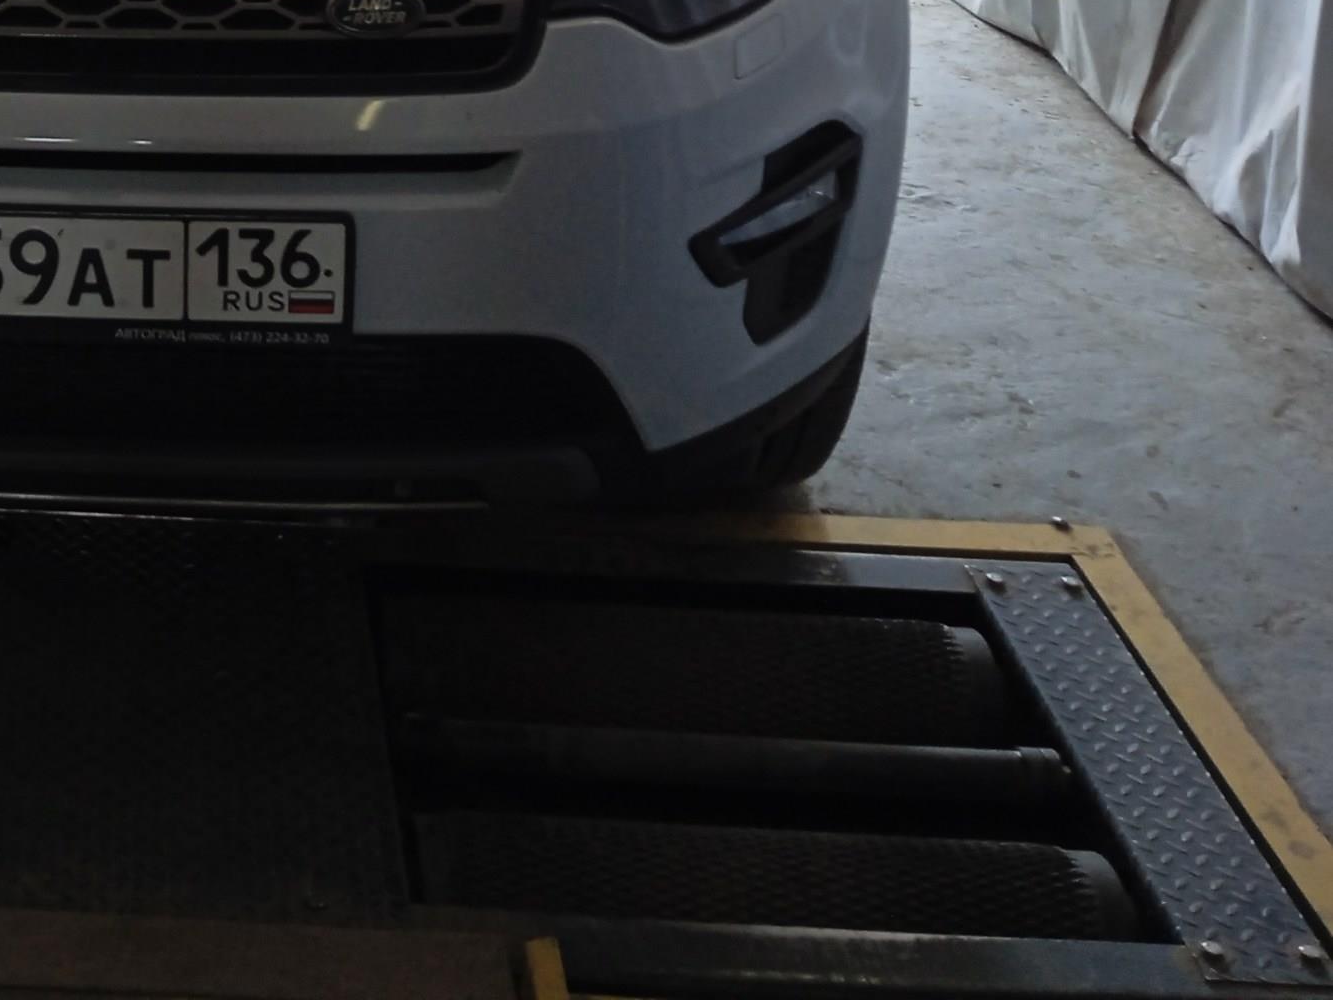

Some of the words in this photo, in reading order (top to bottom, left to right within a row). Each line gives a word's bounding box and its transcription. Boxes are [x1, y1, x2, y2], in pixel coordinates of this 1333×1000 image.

[353, 11, 406, 24] ROVER
[195, 227, 321, 289] 136
[222, 290, 285, 313] RUS
